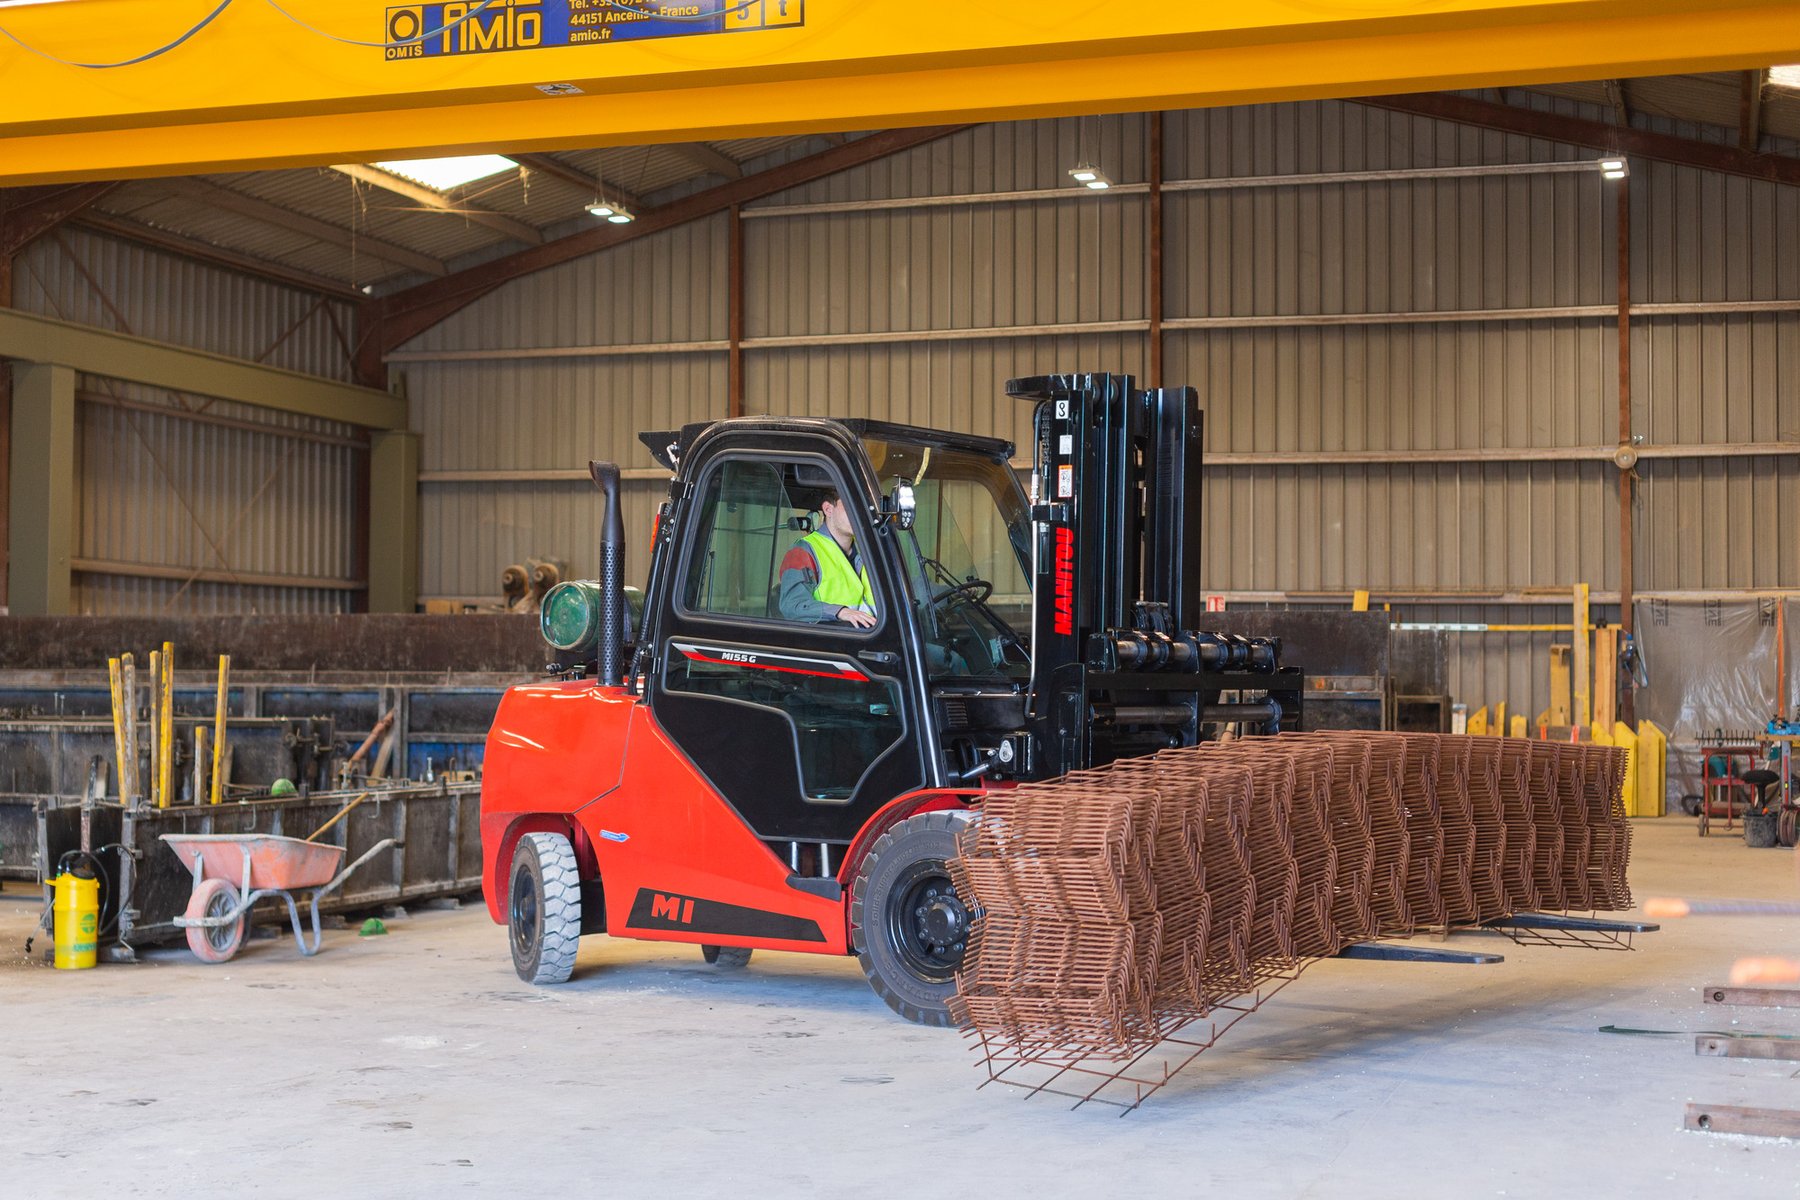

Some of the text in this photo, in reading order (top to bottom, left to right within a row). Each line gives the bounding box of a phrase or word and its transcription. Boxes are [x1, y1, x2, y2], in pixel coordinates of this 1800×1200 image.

[570, 12, 602, 25] 44151
[605, 8, 650, 22] Ancenis
[660, 5, 699, 17] France
[737, 0, 787, 20] 5 t
[570, 28, 611, 42] amio.fr
[386, 45, 423, 59] OMIS
[1054, 527, 1074, 636] MANITOU
[651, 893, 695, 924] MI
